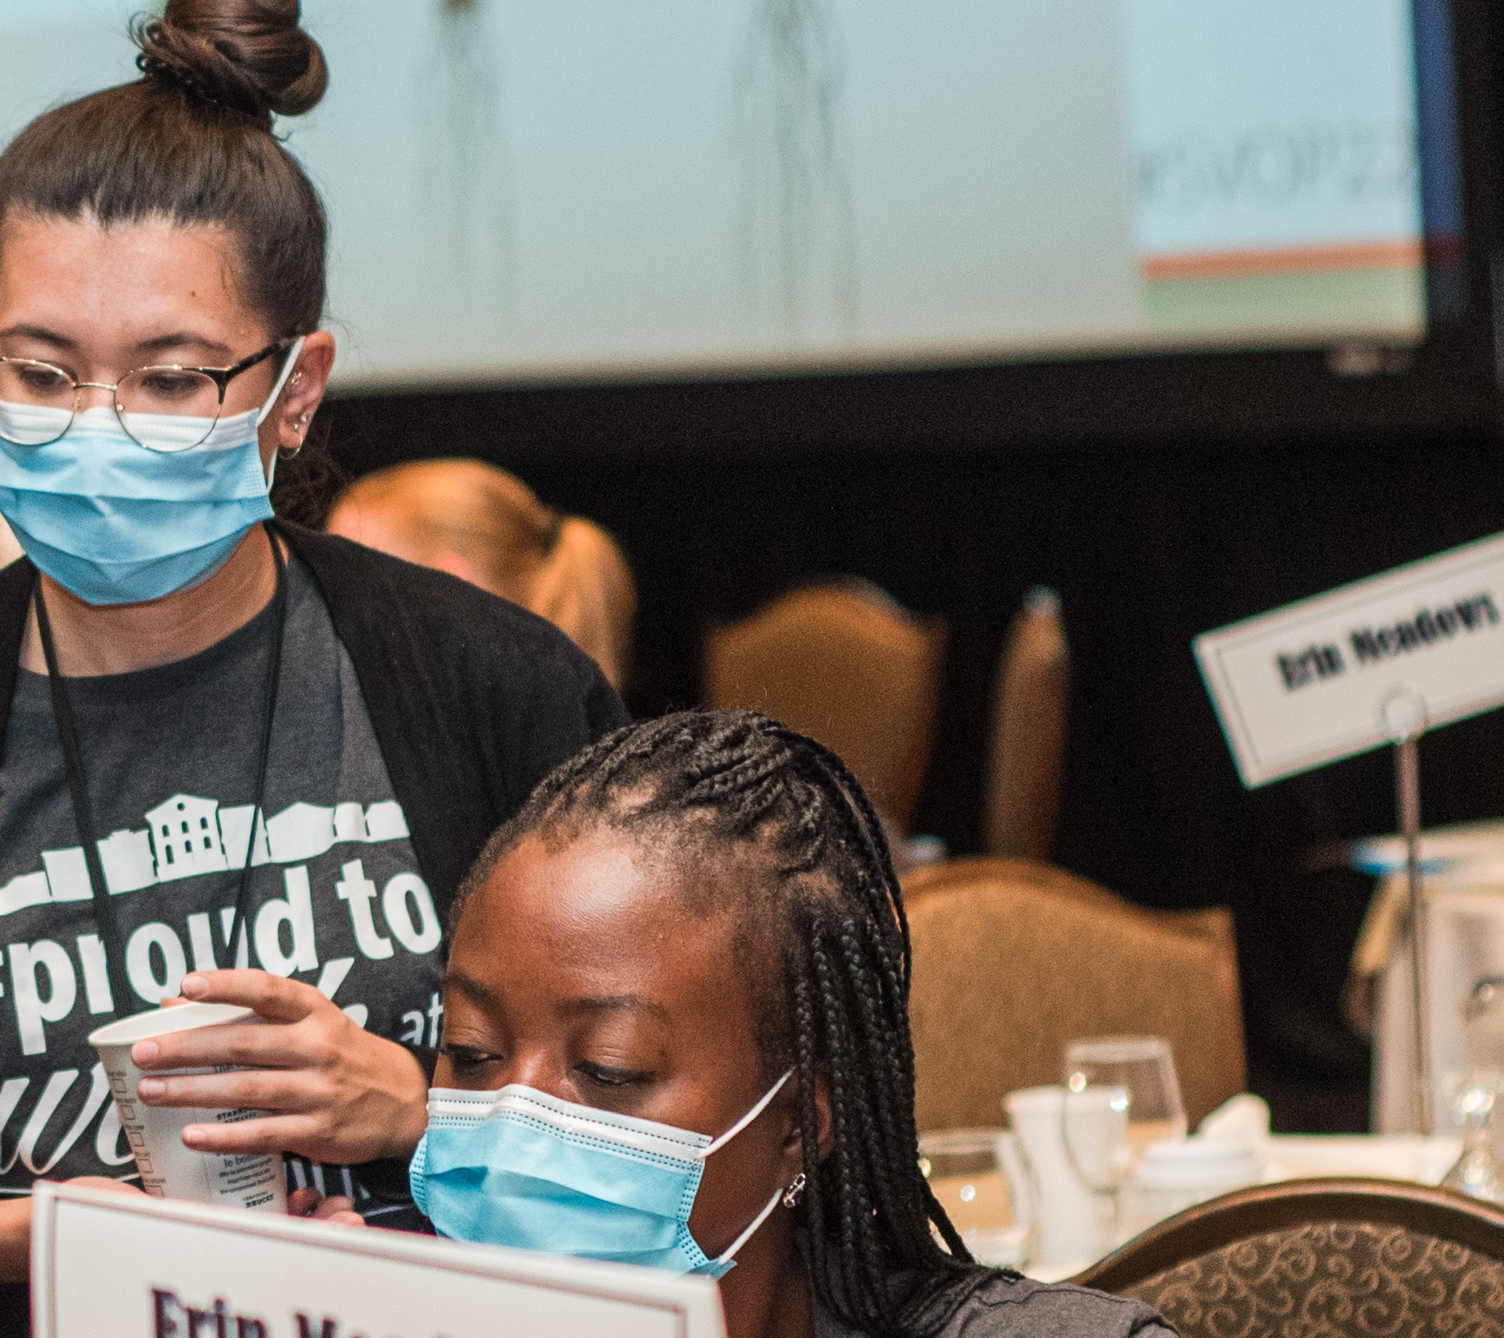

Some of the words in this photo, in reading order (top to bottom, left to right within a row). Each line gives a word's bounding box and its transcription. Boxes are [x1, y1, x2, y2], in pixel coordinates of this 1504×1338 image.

[1276, 643, 1343, 693] Erin
[1351, 591, 1501, 665] Meadows
[336, 858, 442, 959] to
